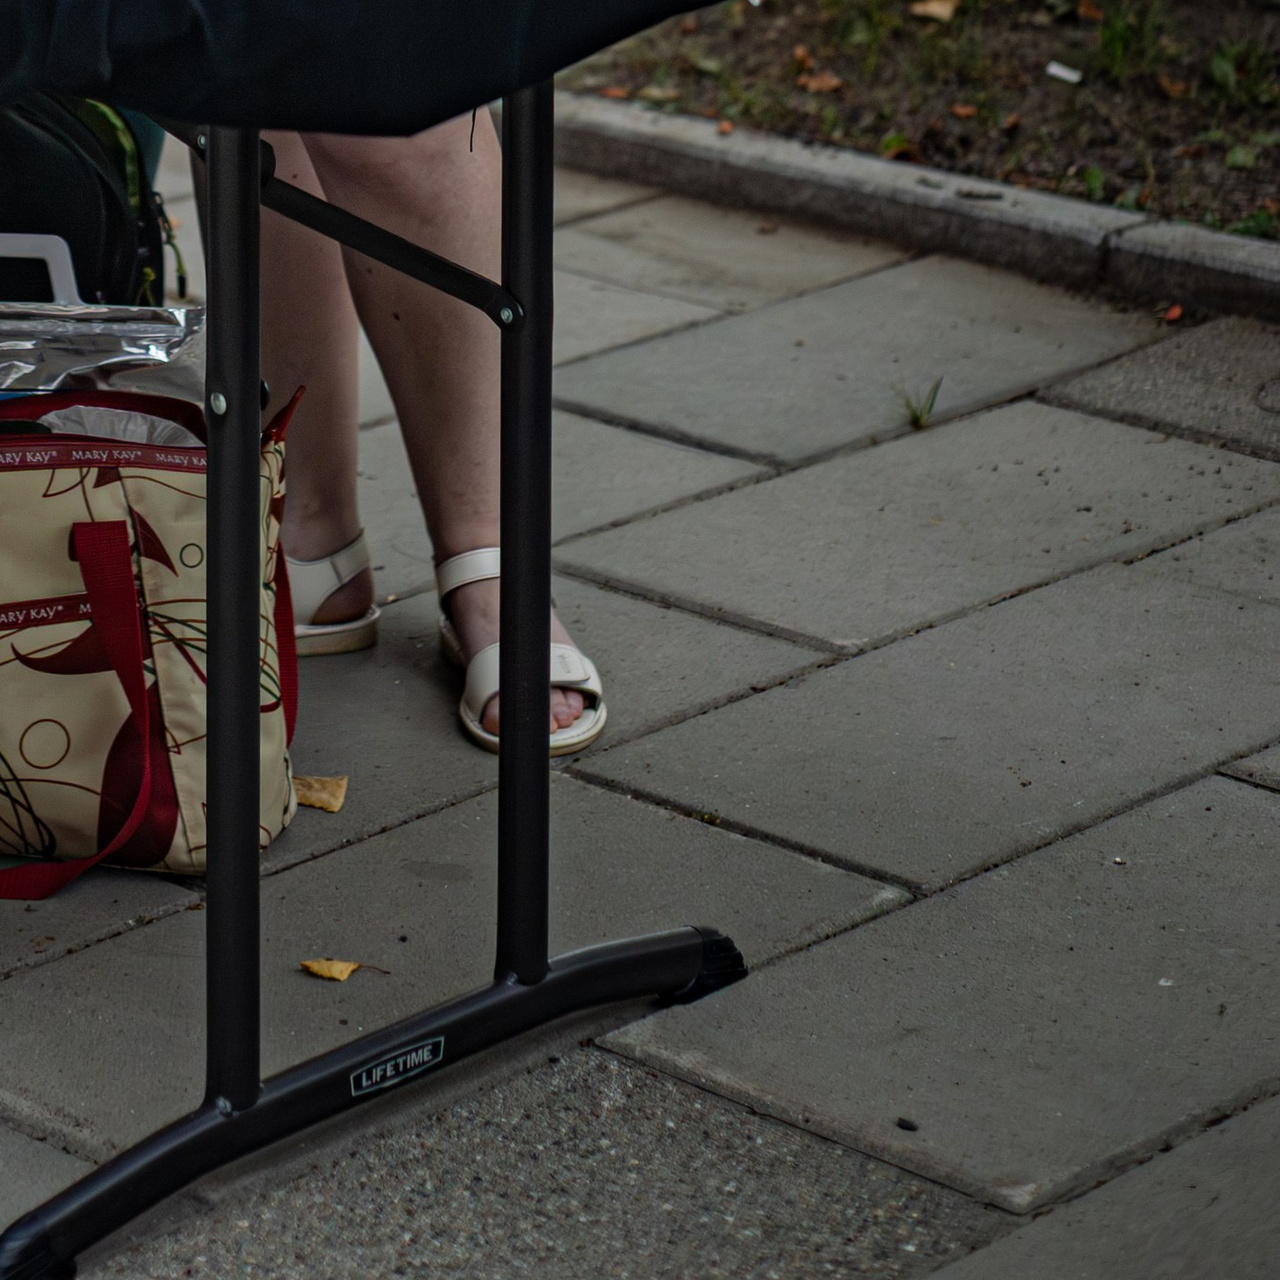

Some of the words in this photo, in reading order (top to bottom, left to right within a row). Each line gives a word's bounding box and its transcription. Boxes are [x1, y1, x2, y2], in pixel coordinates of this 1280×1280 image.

[72, 450, 108, 462] MARY
[156, 453, 188, 466] MARY
[362, 1044, 433, 1088] LIFETIME
